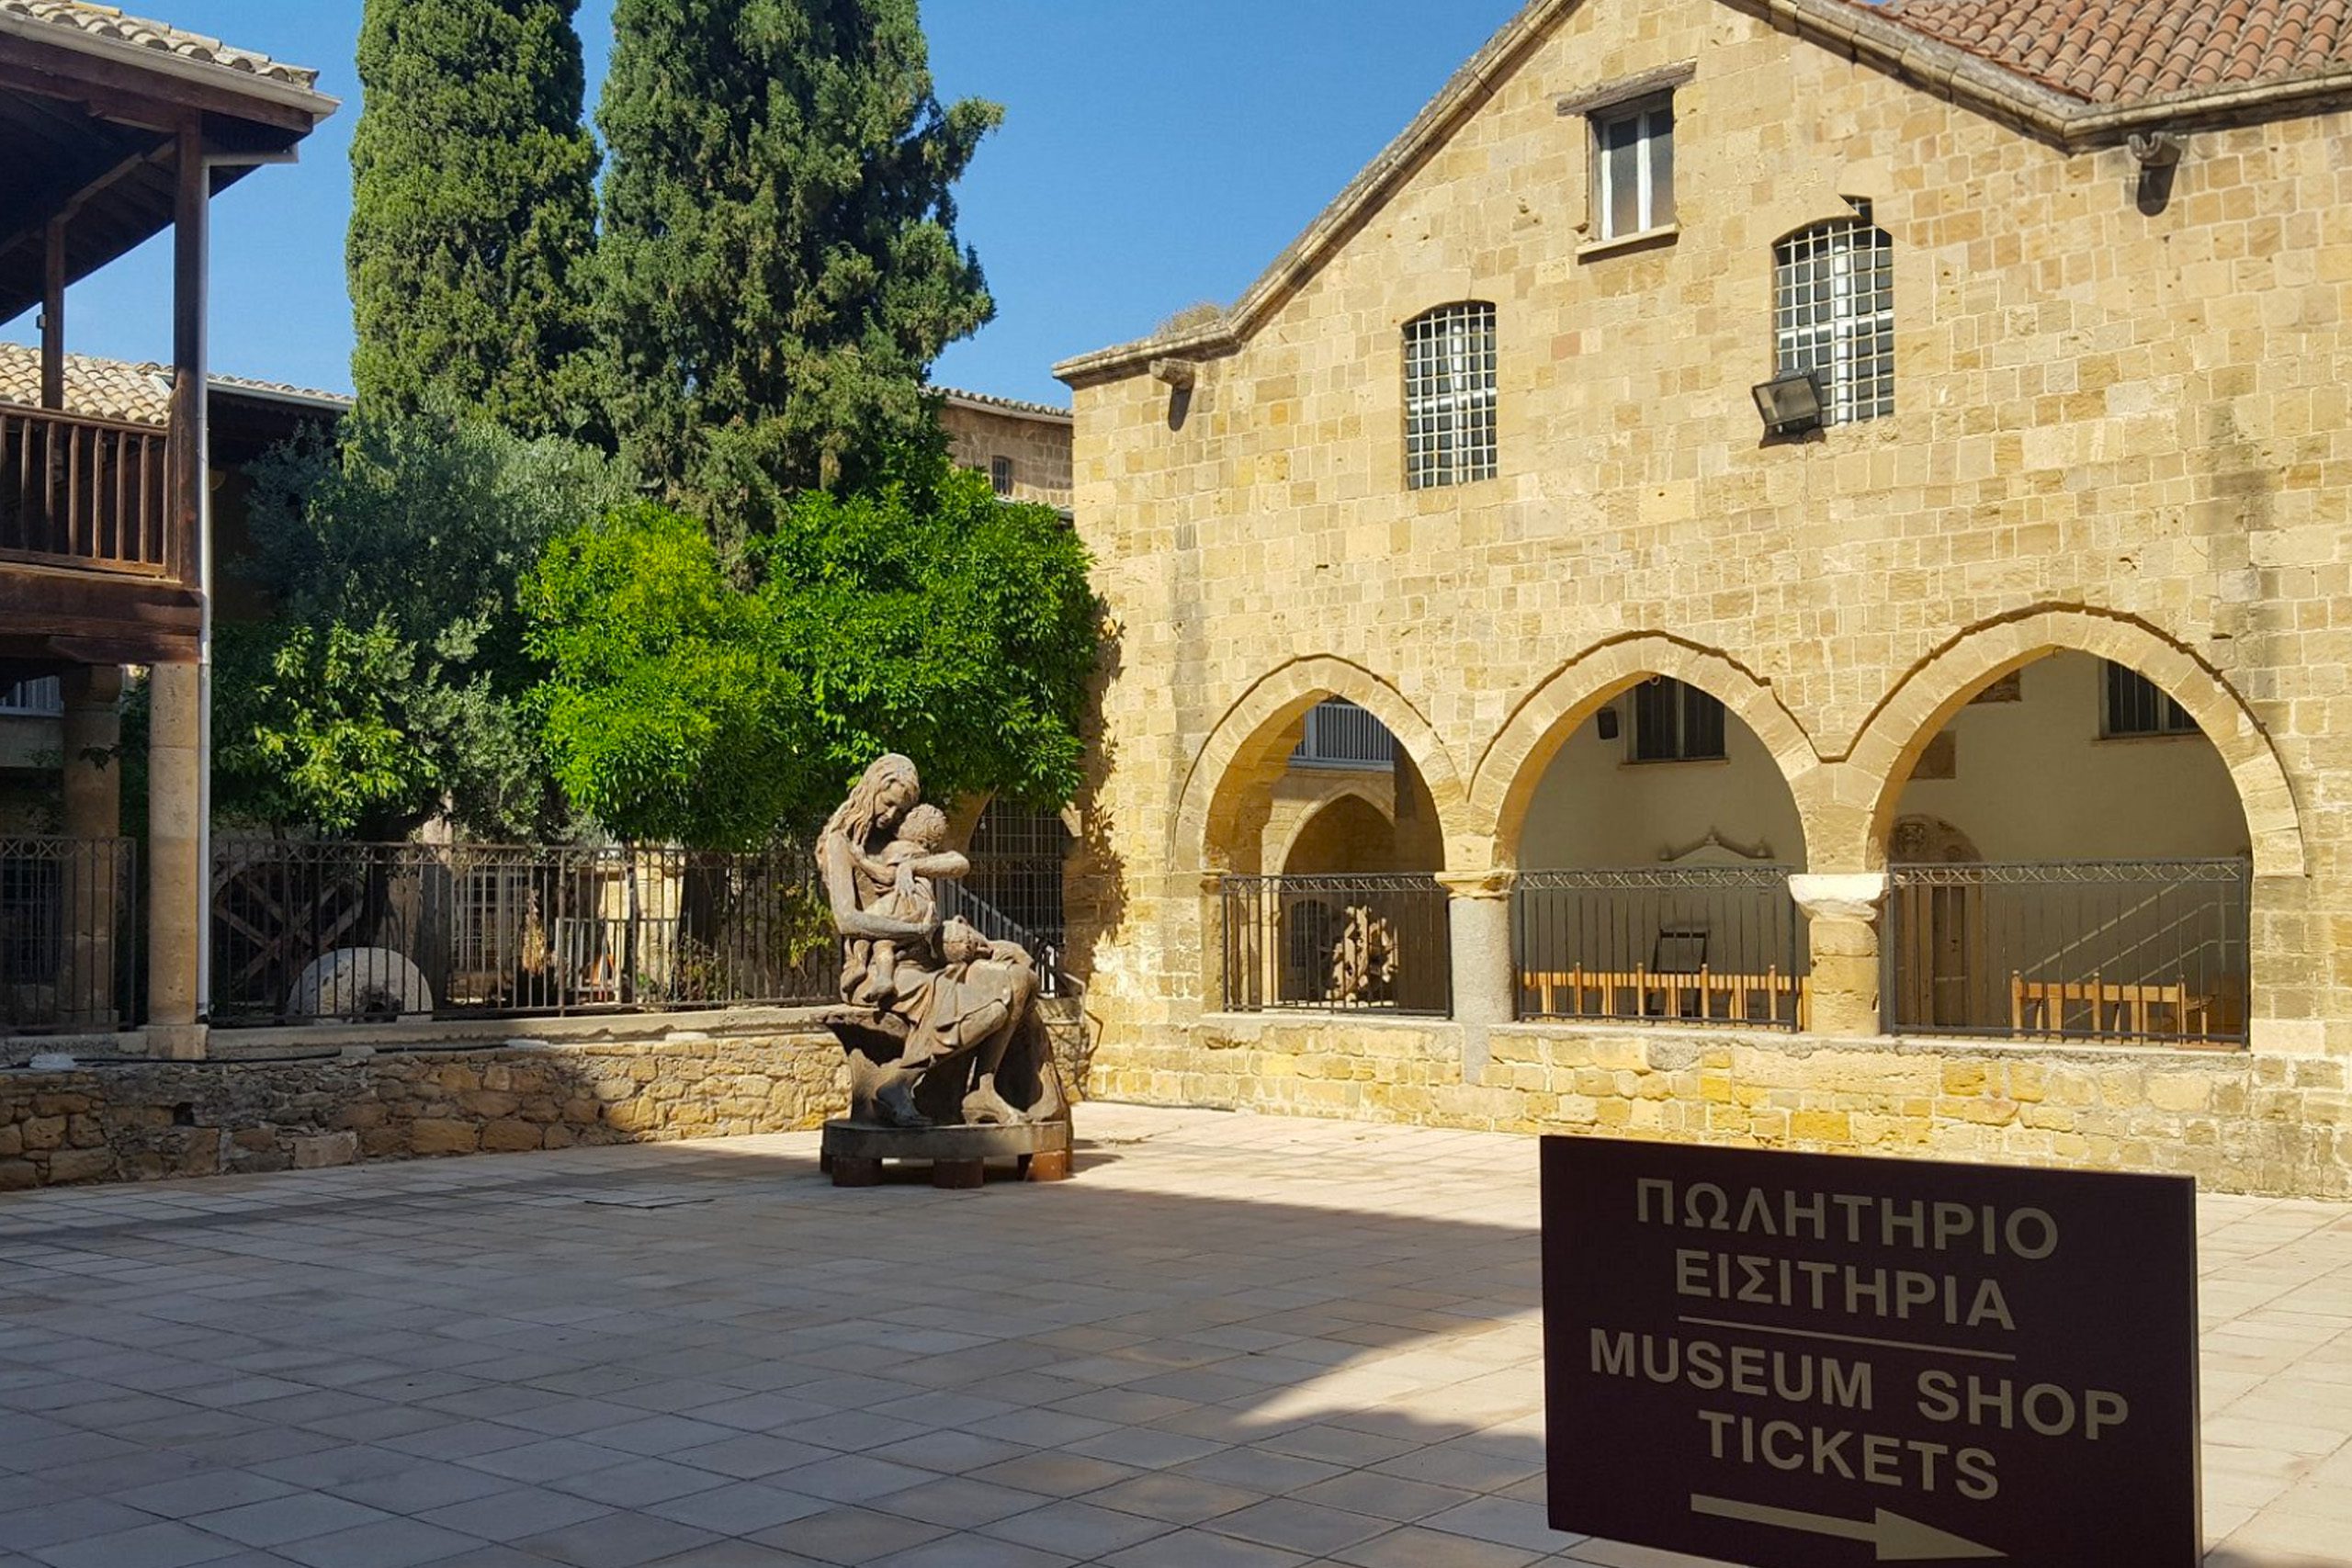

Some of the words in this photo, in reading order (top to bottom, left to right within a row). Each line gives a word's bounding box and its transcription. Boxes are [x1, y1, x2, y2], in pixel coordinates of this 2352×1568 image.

[1636, 1178, 2059, 1259] ΠΩΛΗΤΗΡΙΟ
[1676, 1248, 2017, 1331] ΕΙΣΙΤΗΡΙΑ
[1589, 1328, 1873, 1410] MUSEUM
[1917, 1370, 2130, 1440] SHOP
[1698, 1410, 1999, 1500] TICKETS
